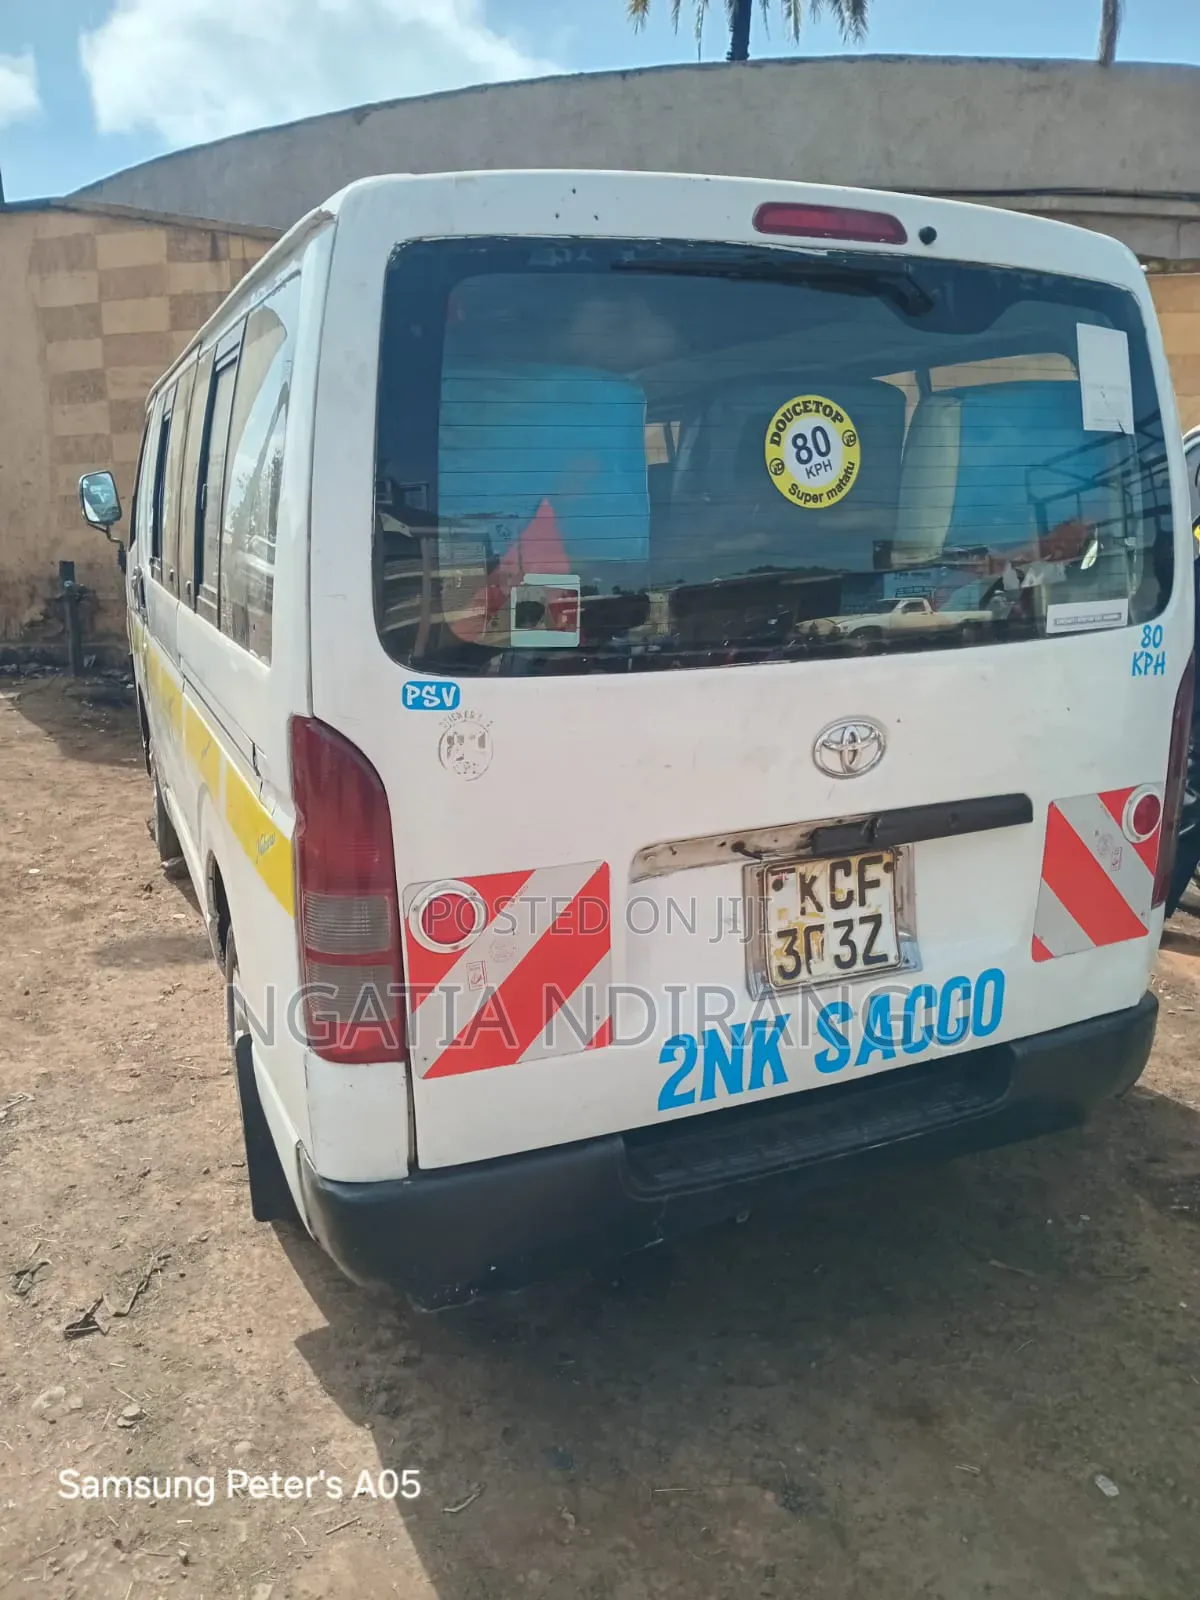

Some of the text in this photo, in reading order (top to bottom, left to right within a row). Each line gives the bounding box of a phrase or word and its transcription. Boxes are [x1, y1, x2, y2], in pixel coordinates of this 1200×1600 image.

[769, 400, 845, 448] DOUCETOP
[791, 425, 831, 465] 80
[788, 461, 855, 504] Super matatu
[804, 458, 833, 479] KPH
[1141, 624, 1163, 649] 80
[1131, 651, 1166, 677] KPH
[405, 684, 457, 708] PSV
[800, 854, 884, 916] KCF
[657, 967, 1006, 1112] 2NK SACCO
